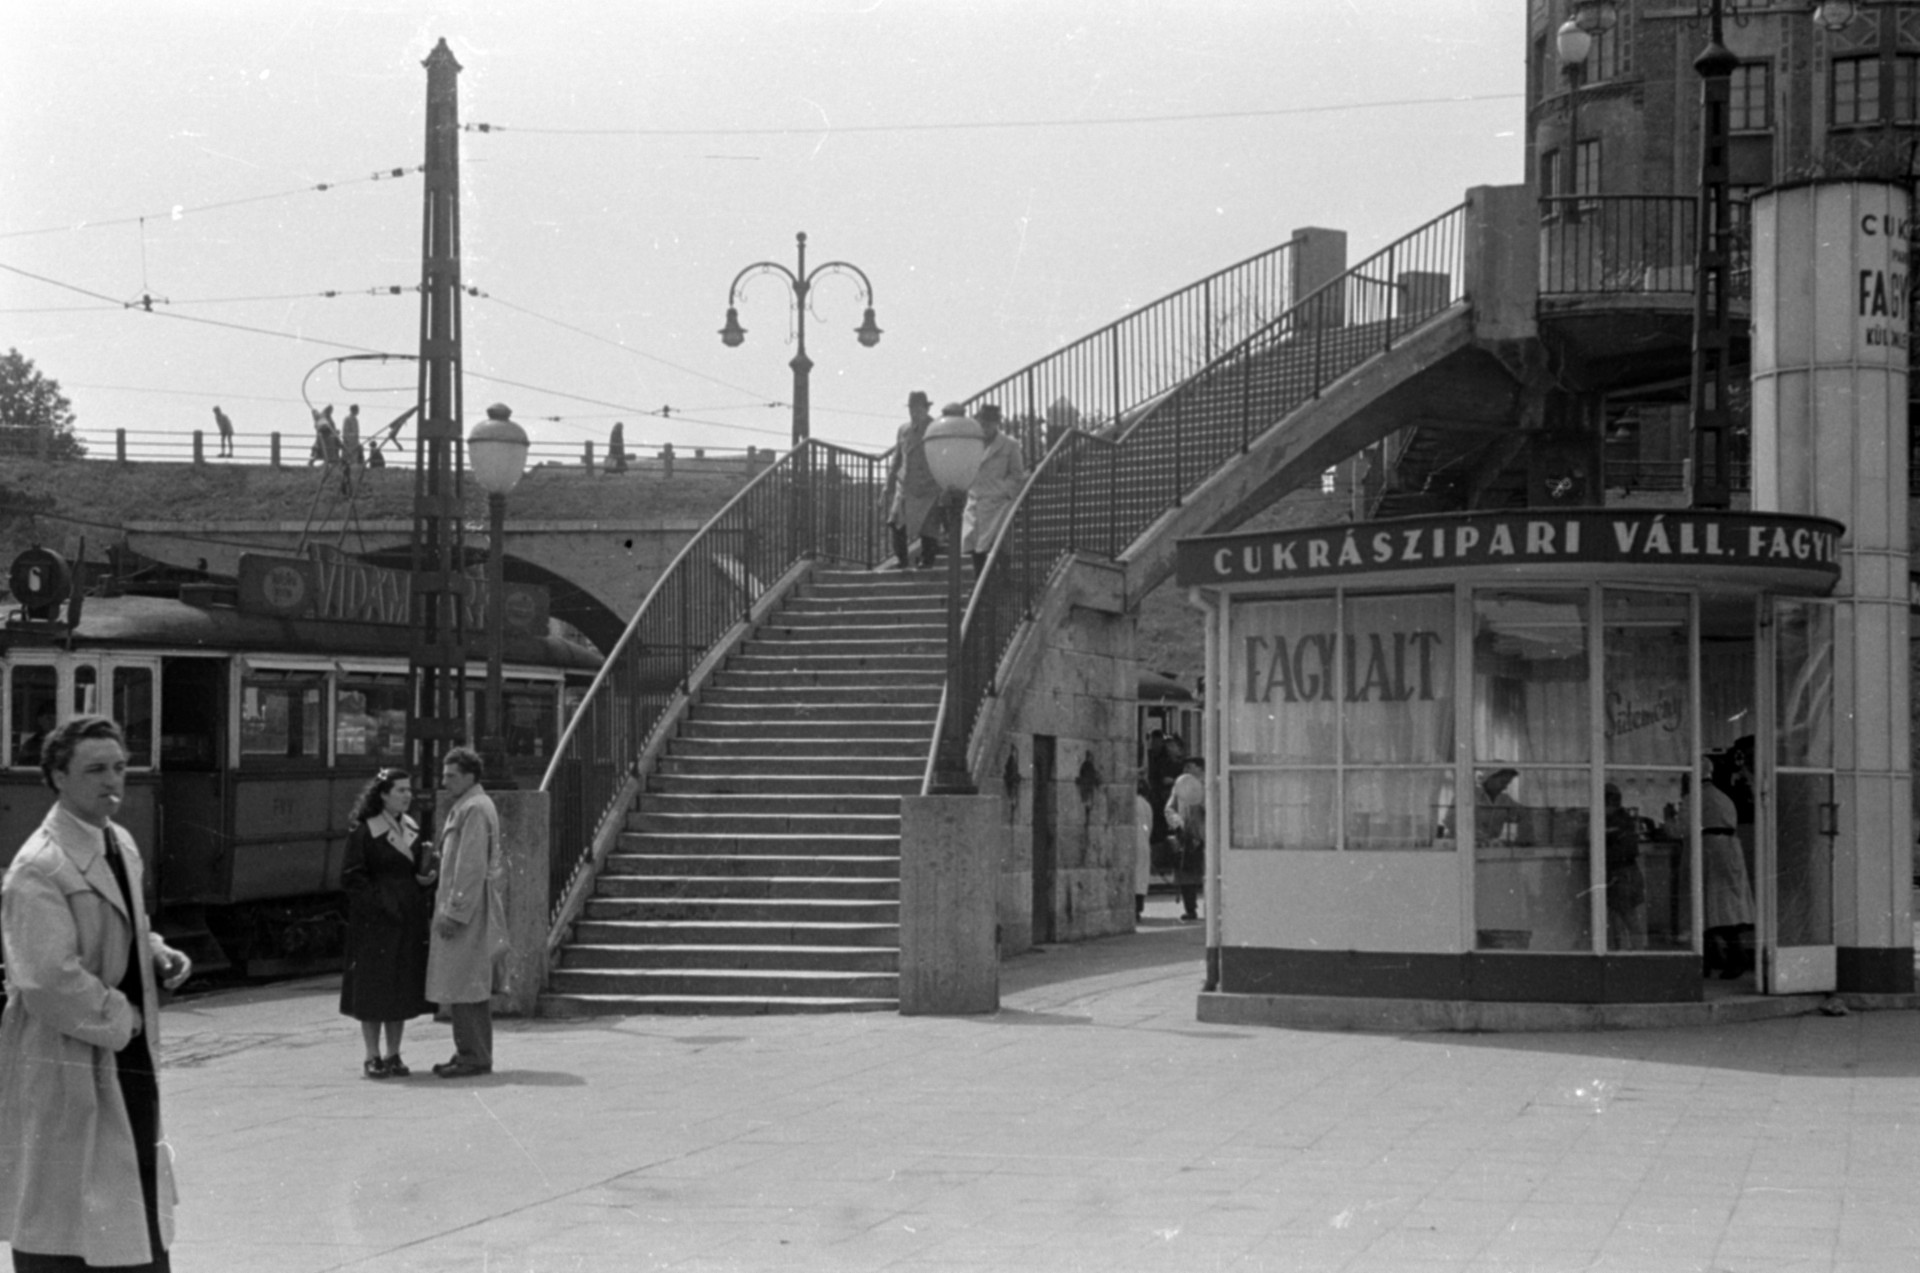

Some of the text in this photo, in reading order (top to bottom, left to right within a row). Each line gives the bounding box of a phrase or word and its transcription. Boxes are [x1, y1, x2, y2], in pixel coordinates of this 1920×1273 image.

[1213, 521, 1580, 575] CUKRÁSZIPARI
[1613, 514, 1735, 557] VÁLL.
[29, 566, 42, 592] 6
[1244, 631, 1442, 704] FAGYLALT
